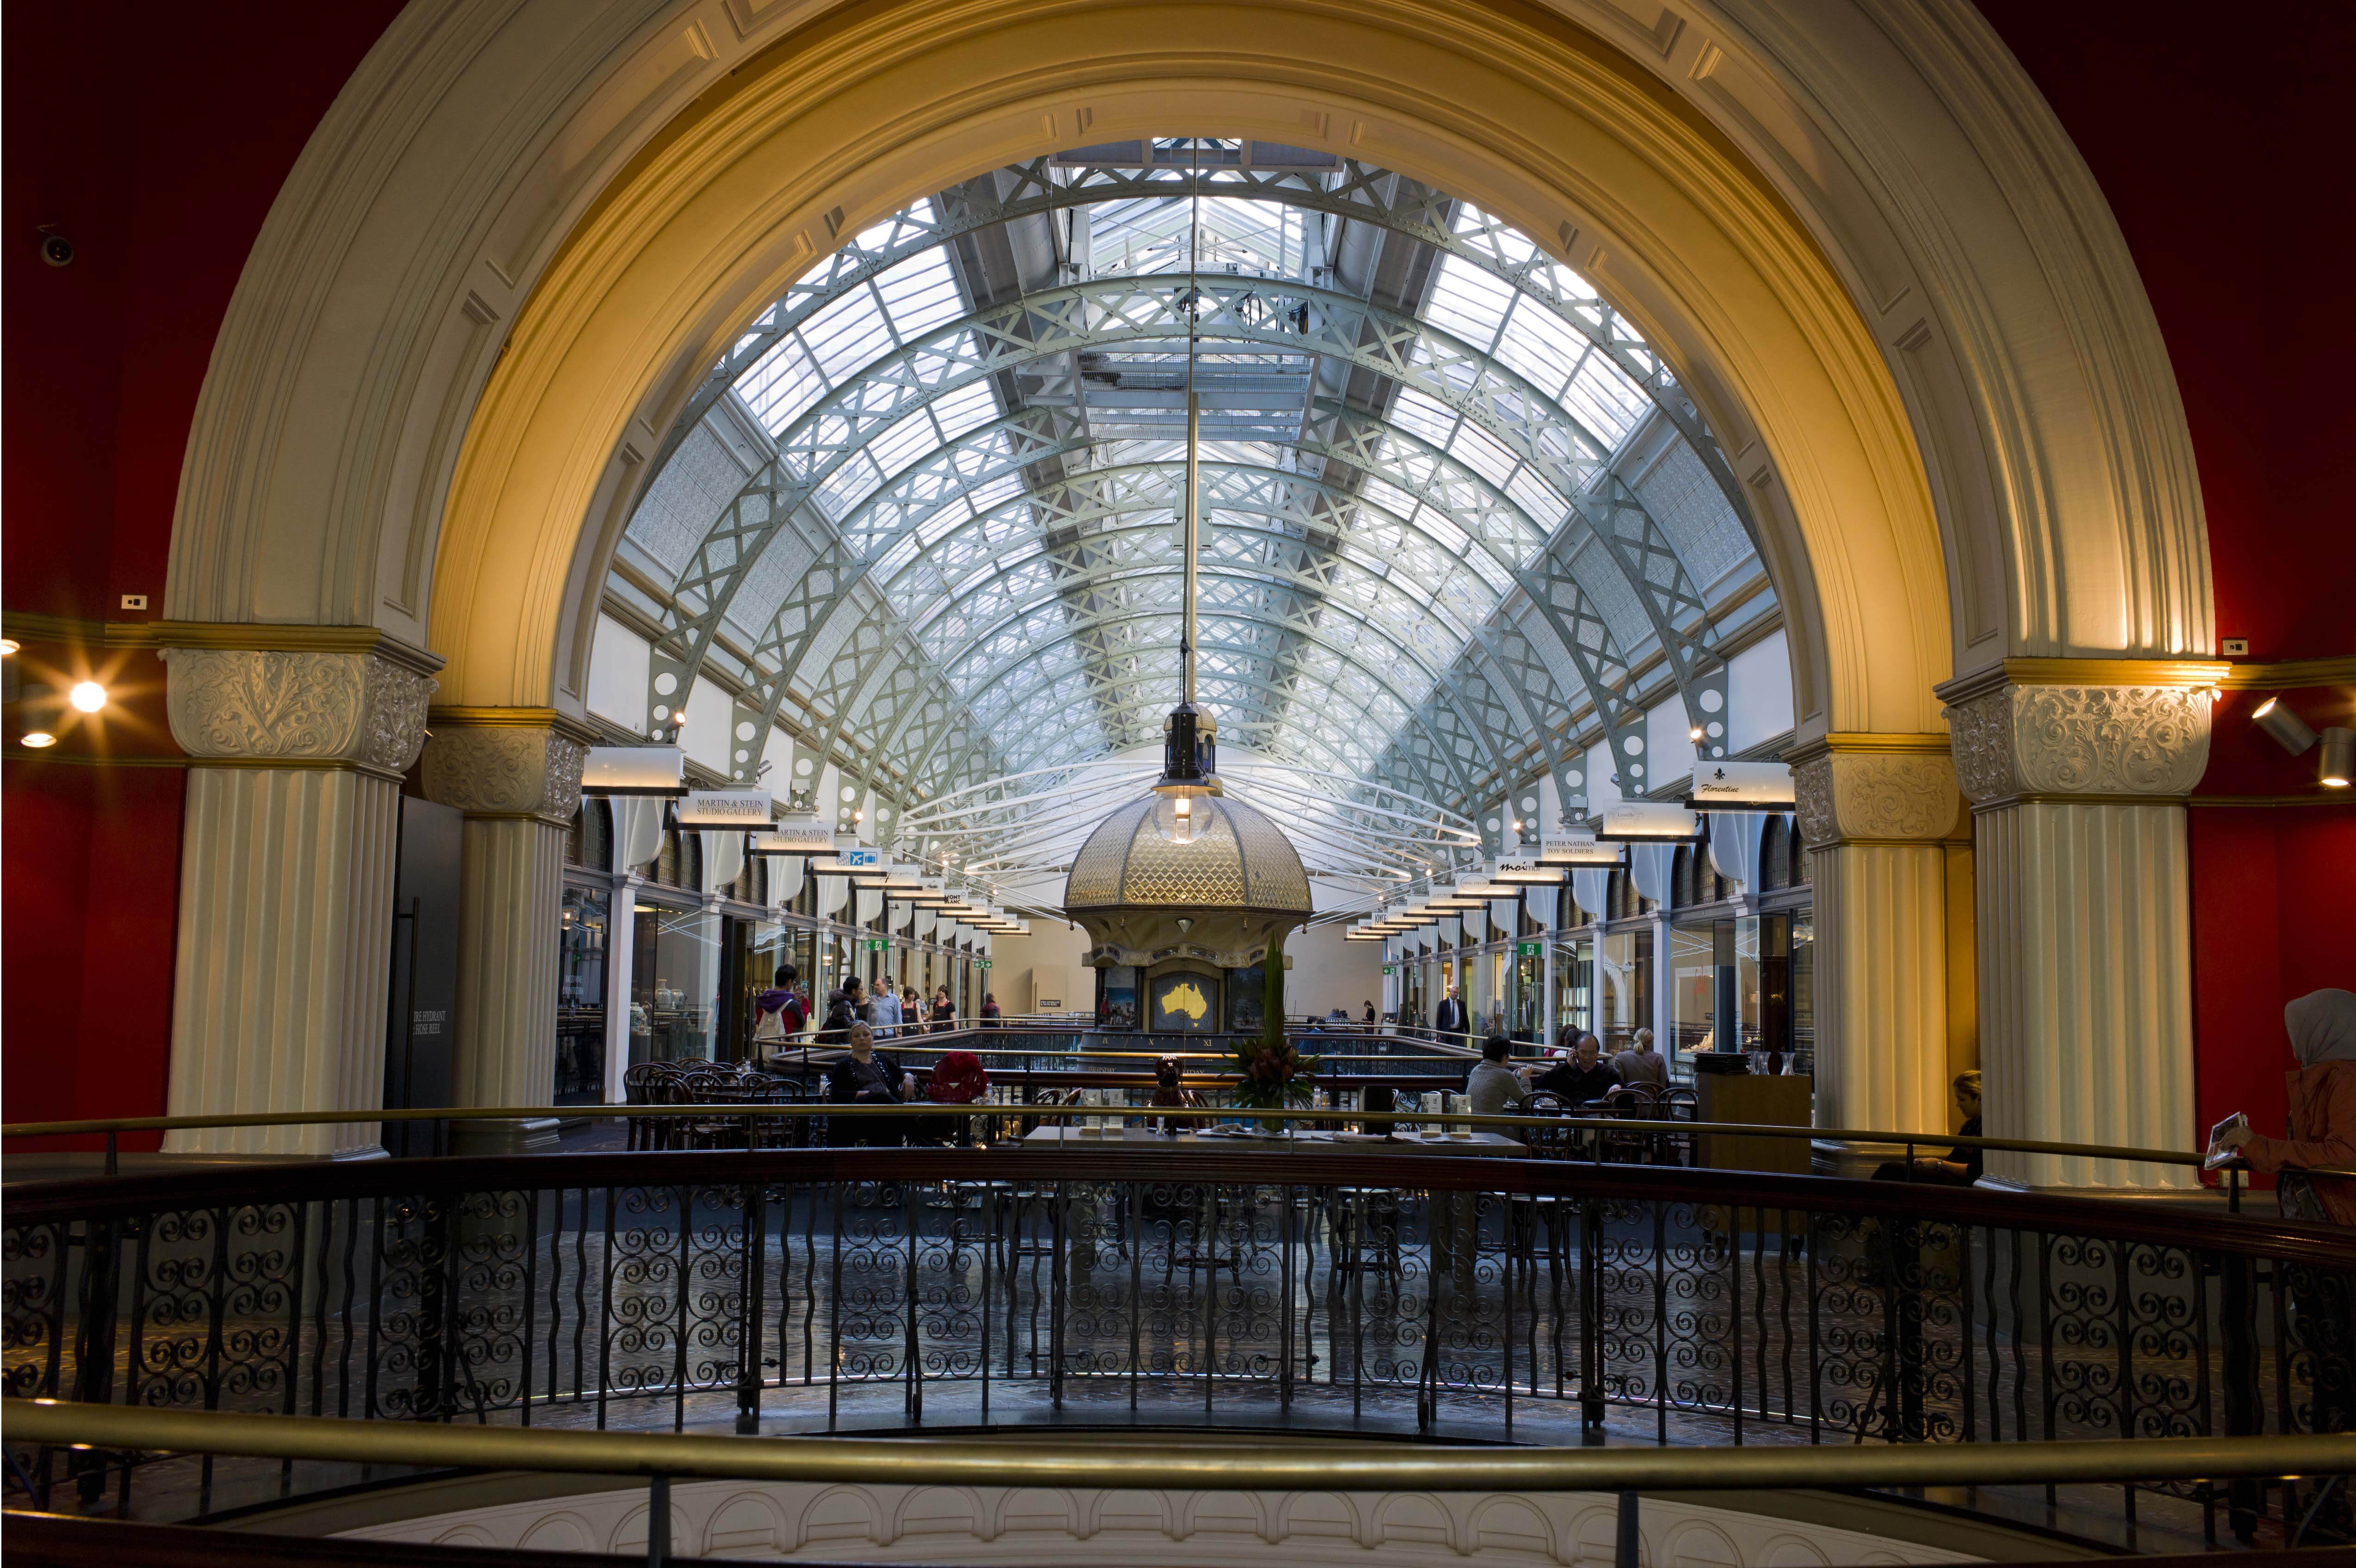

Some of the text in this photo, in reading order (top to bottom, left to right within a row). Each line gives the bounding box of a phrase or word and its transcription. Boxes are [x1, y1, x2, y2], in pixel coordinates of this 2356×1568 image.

[1701, 784, 1740, 793] Florentine
[1375, 914, 1386, 924] JOYCE
[423, 1011, 446, 1022] HYDRANT
[416, 1024, 429, 1035] HOSE
[429, 1023, 441, 1034] REEL
